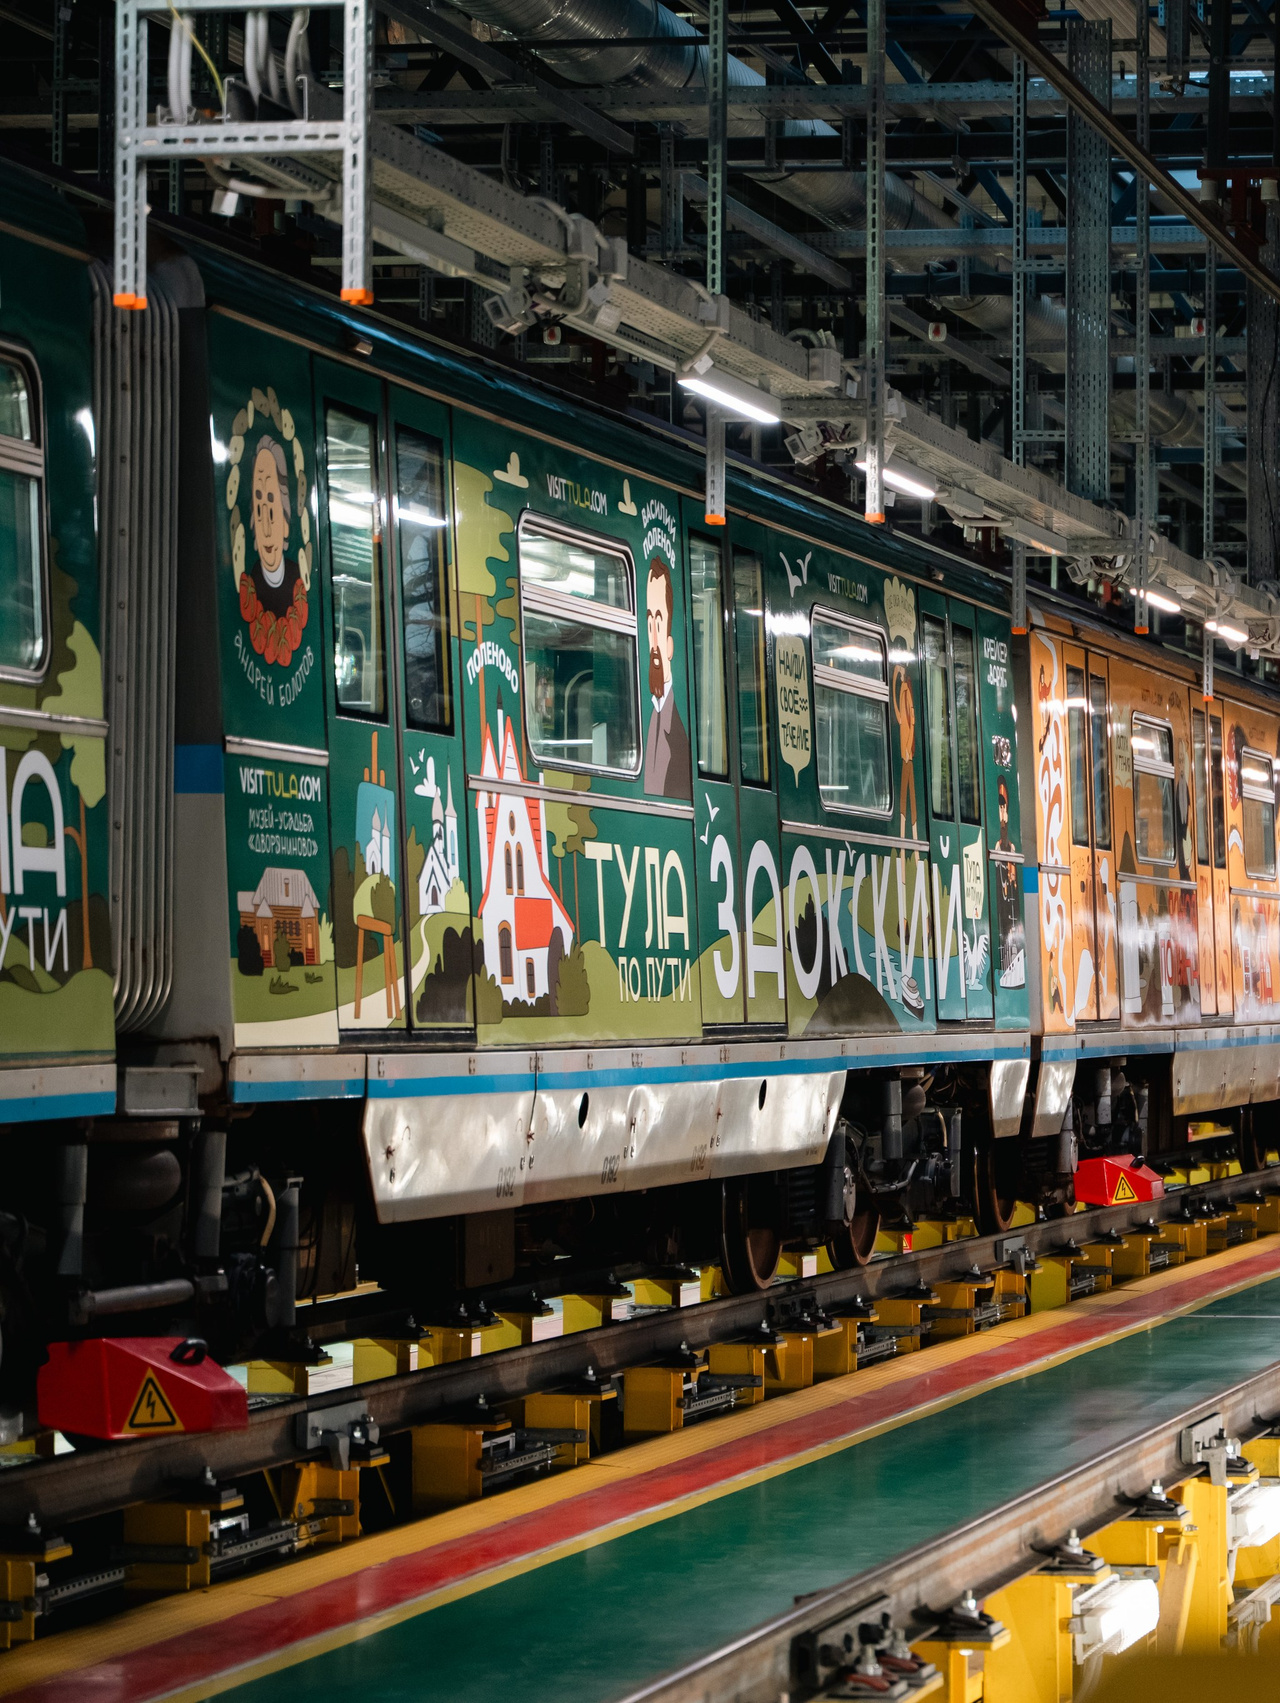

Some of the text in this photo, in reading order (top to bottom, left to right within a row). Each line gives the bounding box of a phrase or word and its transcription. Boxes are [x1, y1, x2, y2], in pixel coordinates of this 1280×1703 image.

[546, 473, 608, 516] VISITTULA.COM
[641, 499, 677, 543] ВАСИЛИЙ
[642, 527, 676, 570] ПОЛЕНОВ
[234, 629, 315, 707] АНДРЕЙ БОЛОТОВ
[466, 641, 519, 694] ПОЛЕНОВО
[778, 647, 806, 683] НАЙДИ
[780, 685, 801, 716] СВОЁ
[239, 765, 322, 802] VISITTULA.COM
[584, 840, 690, 950] ТУЛА
[710, 833, 966, 1001] ЗАОКСКИЙ
[618, 955, 692, 1003] ПО ПУТИ
